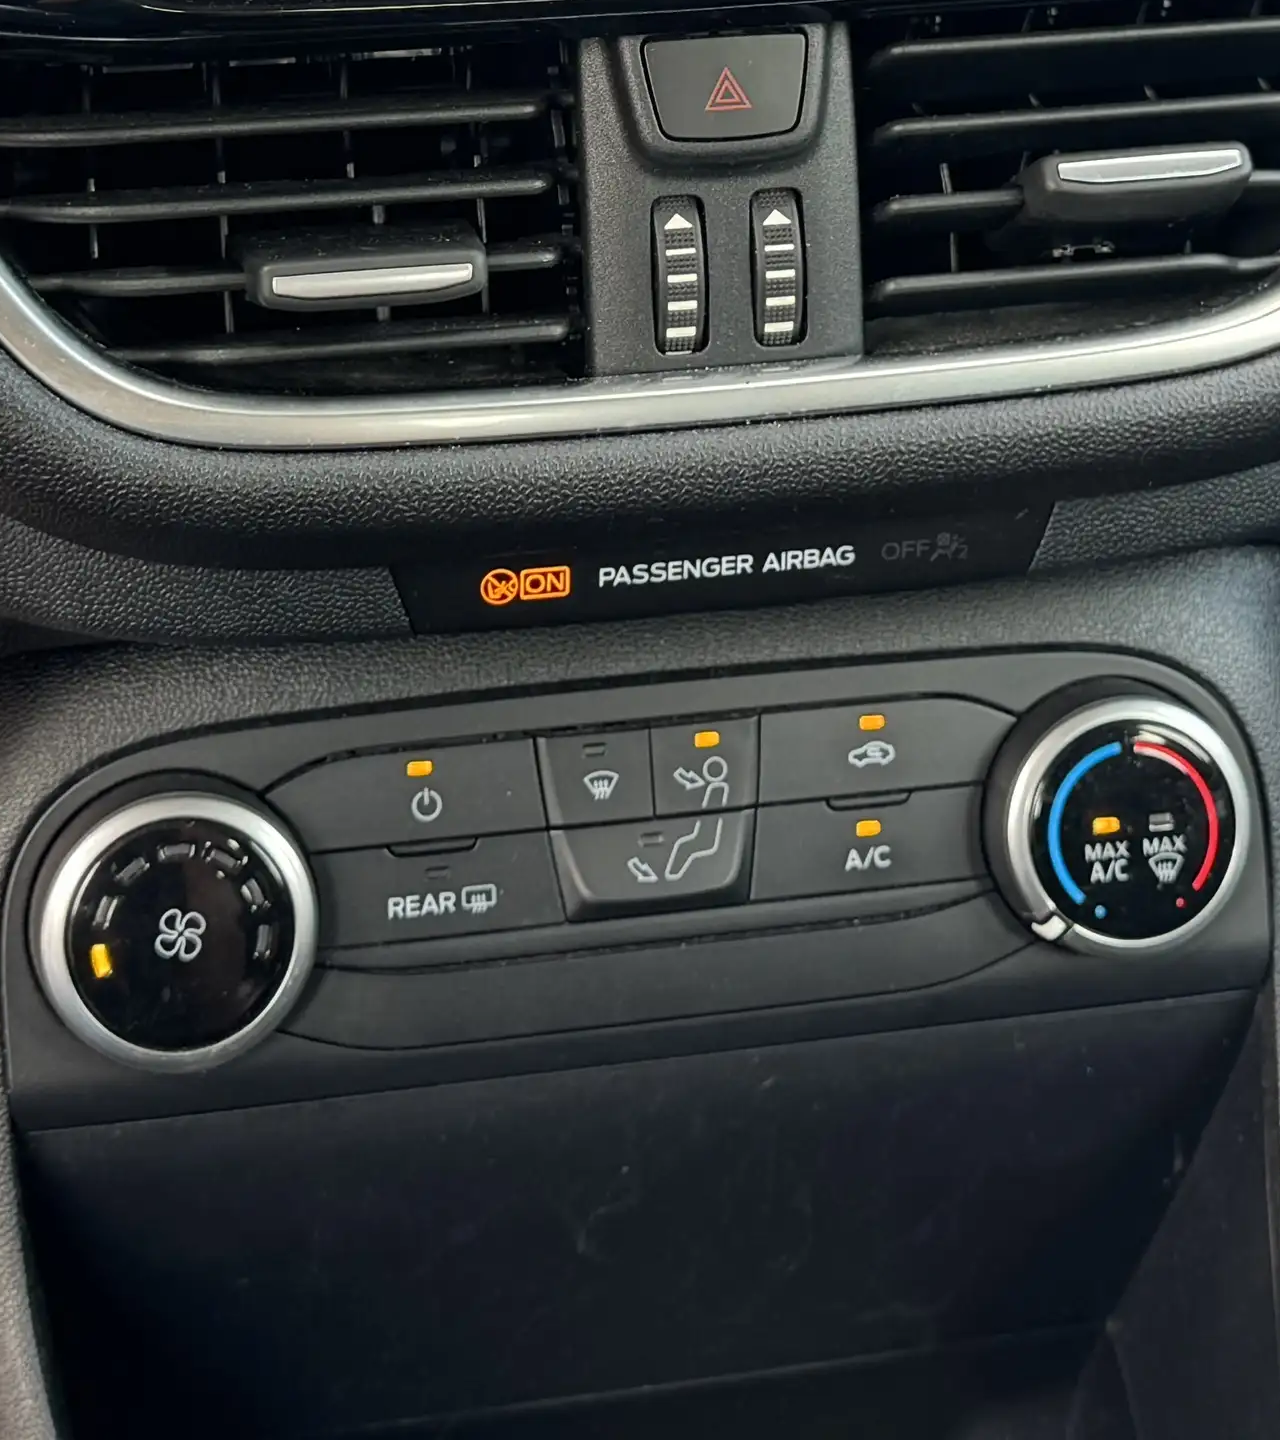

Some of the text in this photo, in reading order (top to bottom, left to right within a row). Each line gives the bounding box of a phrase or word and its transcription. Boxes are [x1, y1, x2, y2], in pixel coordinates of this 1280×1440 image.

[881, 541, 930, 562] OFF
[598, 544, 856, 587] PASSENGER AIRBAG
[524, 571, 567, 596] ON
[1084, 842, 1131, 862] MAX
[1142, 835, 1187, 856] MAX
[844, 847, 891, 871] A/C
[1090, 860, 1129, 883] A/C
[387, 890, 457, 920] REAR
